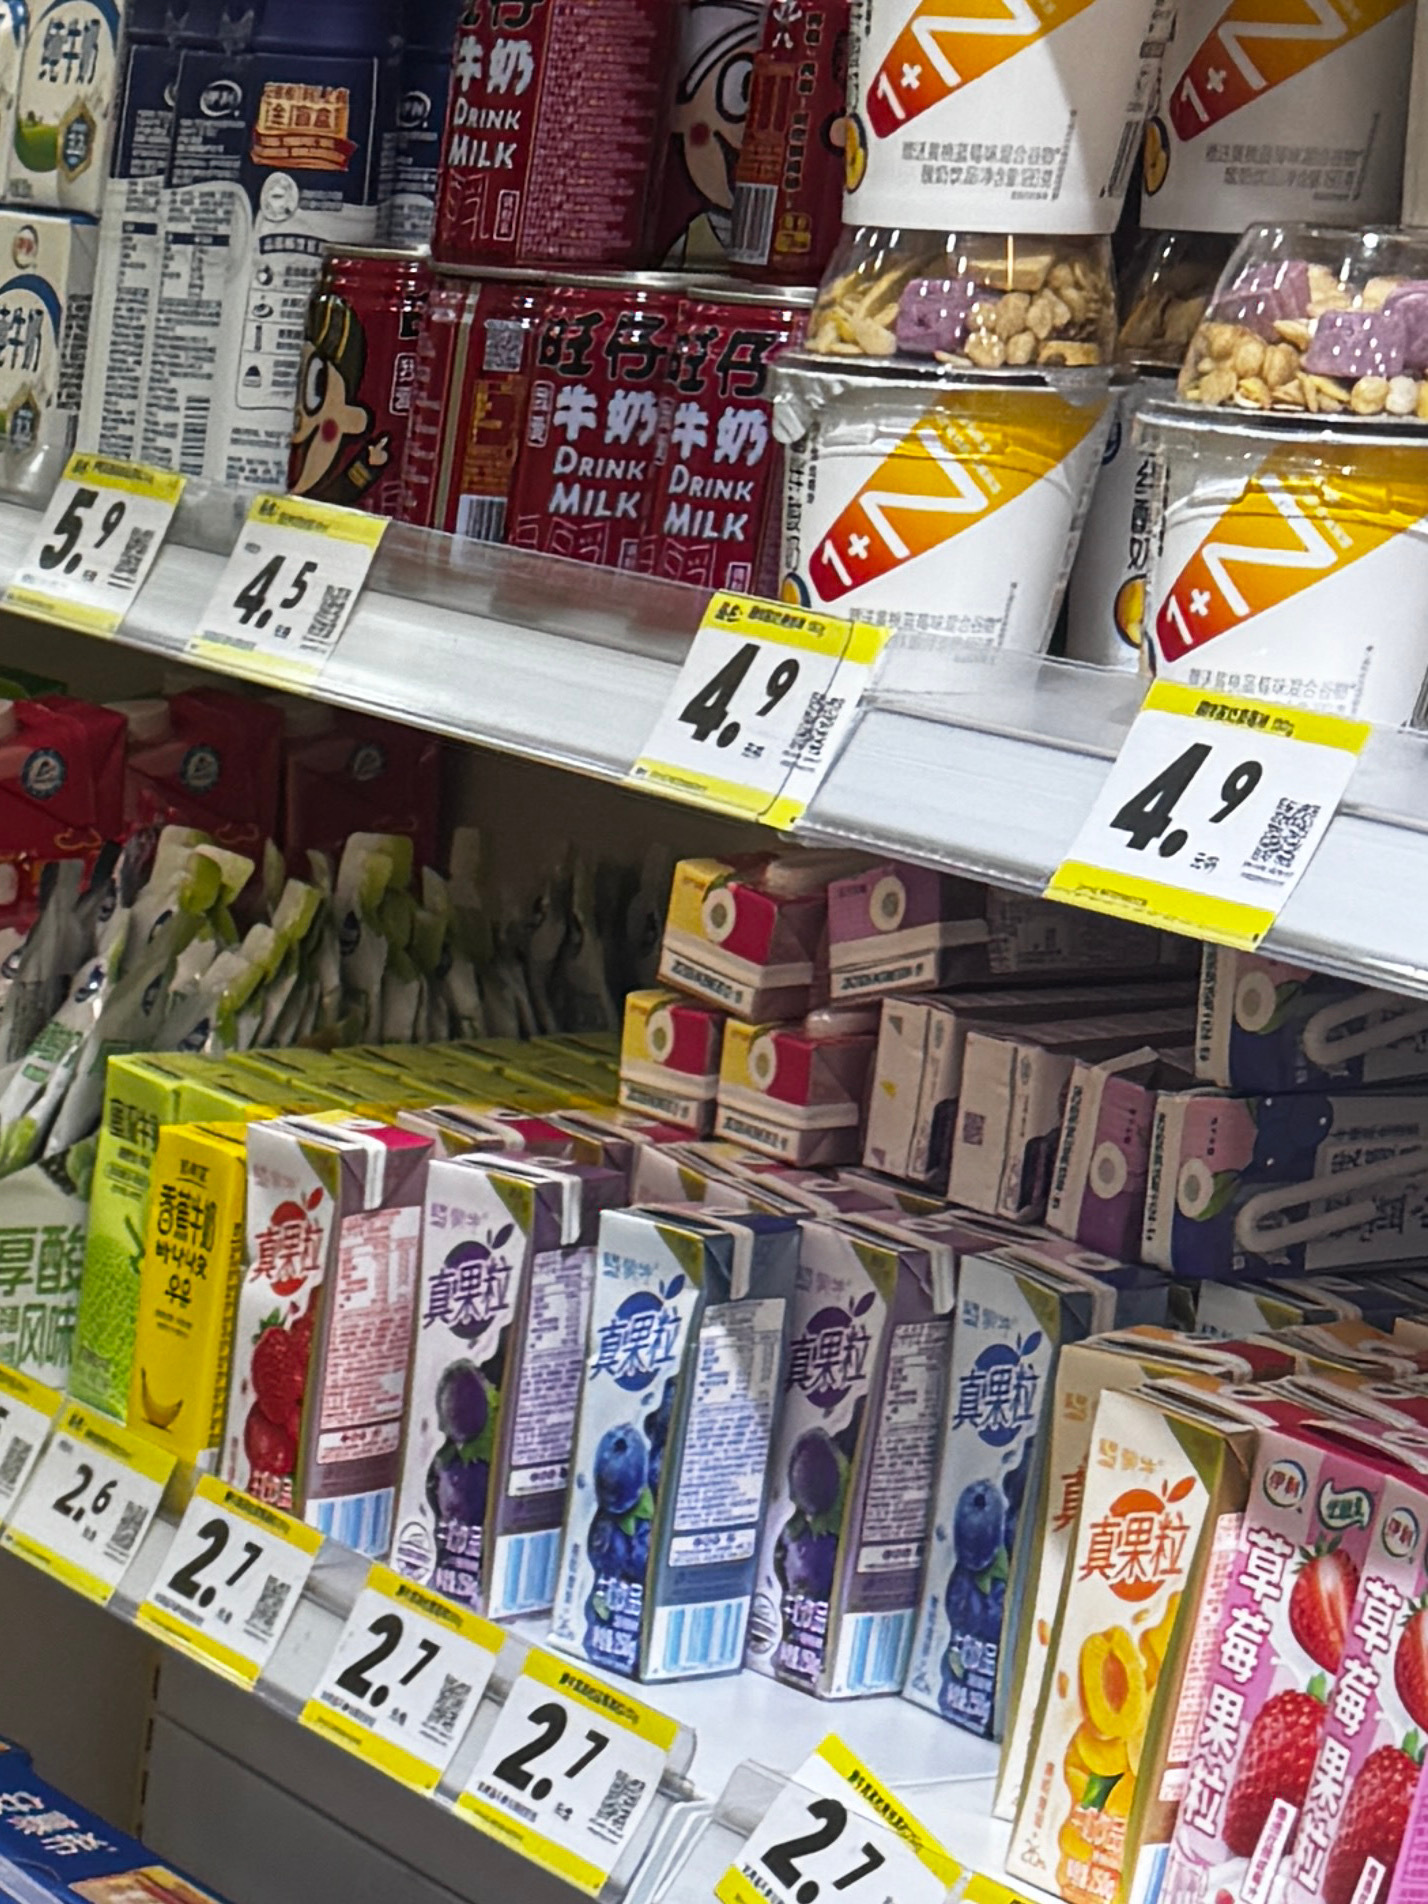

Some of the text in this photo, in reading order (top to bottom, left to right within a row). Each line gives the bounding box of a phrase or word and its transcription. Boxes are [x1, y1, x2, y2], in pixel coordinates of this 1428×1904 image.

[455, 35, 534, 95] 牛奶
[453, 97, 521, 130] DRINK
[448, 136, 518, 169] MILK
[553, 384, 660, 446] 牛奶
[673, 401, 769, 466] 牛奶
[553, 445, 644, 481] DRINK
[668, 464, 754, 502] DRINK
[39, 488, 126, 574] 5.9
[549, 482, 640, 519] MILK
[664, 502, 748, 541] MILK
[234, 556, 317, 629] 4.5
[679, 643, 800, 748] 4.9
[1110, 743, 1263, 858] 4.9
[249, 1223, 323, 1286] 真果粒
[423, 1257, 514, 1328] 真果粒
[590, 1308, 681, 1381] 真果粒
[785, 1328, 875, 1397] 真果粒
[952, 1370, 1042, 1434] 真果粒
[53, 1463, 118, 1522] 2.6
[167, 1518, 263, 1607] 2.7
[1079, 1511, 1190, 1583] 真果粒
[336, 1613, 440, 1707] 2.7
[492, 1703, 609, 1800] 2.7
